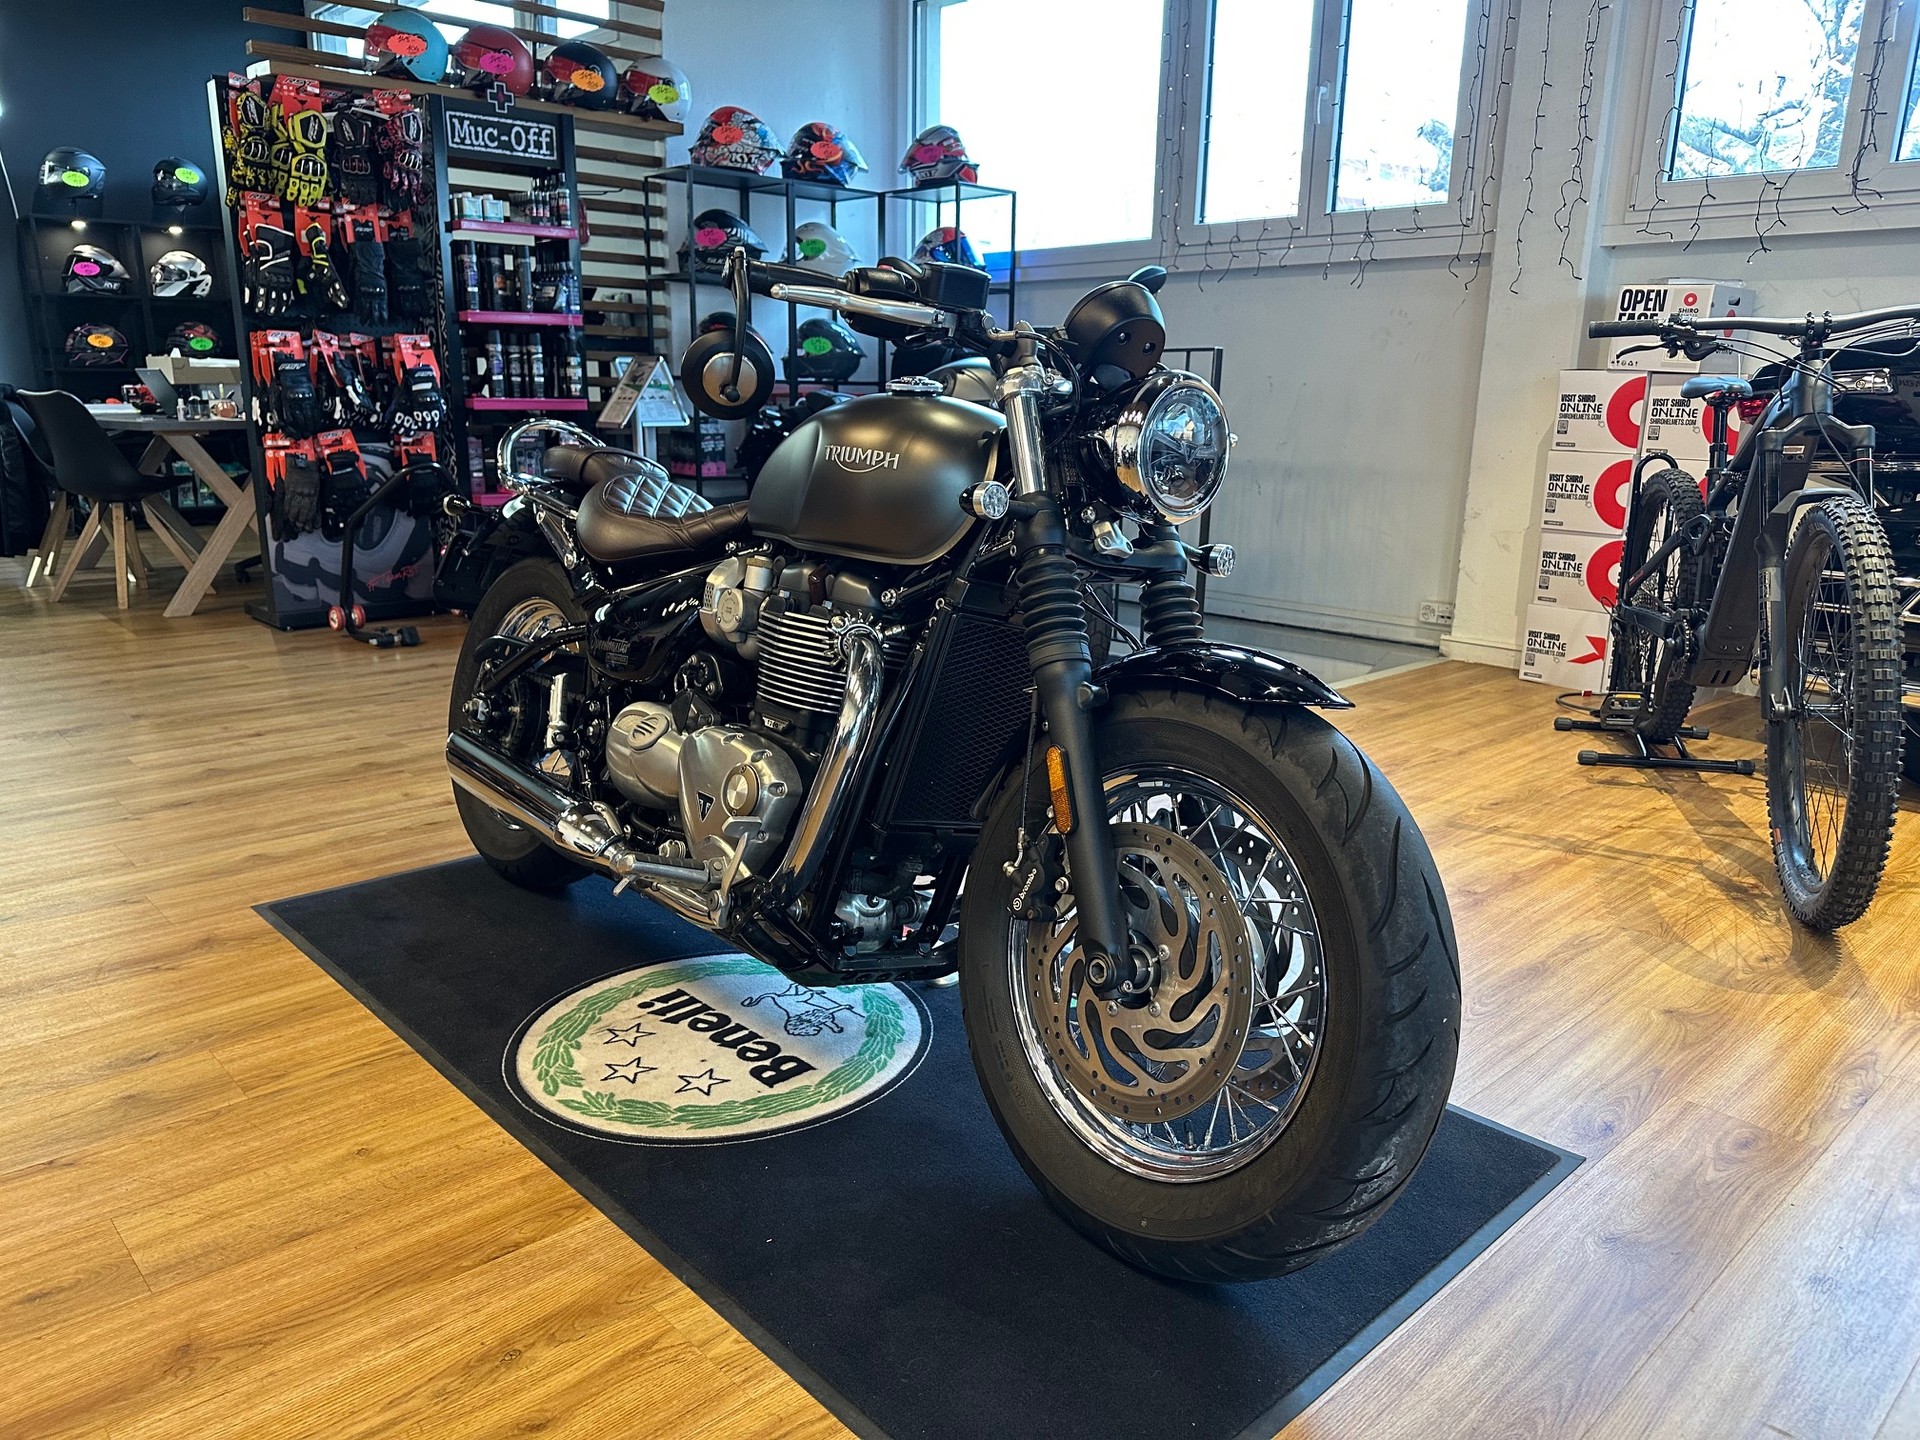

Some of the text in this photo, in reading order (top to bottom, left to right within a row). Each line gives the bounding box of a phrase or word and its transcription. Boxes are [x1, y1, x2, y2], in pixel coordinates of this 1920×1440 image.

[284, 77, 316, 87] RST
[451, 118, 551, 155] Muc-Off
[1619, 288, 1668, 312] OPEN
[1561, 394, 1596, 403] VISIT SHIRO
[1652, 398, 1691, 407] VISIT SHIRO
[1560, 403, 1603, 413] ONLINE
[1651, 407, 1698, 418] ONLINE
[824, 444, 900, 472] TRIUMPH
[1548, 473, 1584, 483] VISIT SHIRO
[1548, 482, 1590, 494] ONLINE
[1542, 550, 1576, 561] VISIT SHIRO
[1541, 559, 1583, 572] ONLINE
[1527, 637, 1567, 651] ONLINE
[1018, 868, 1038, 900] brembo
[637, 987, 818, 1089] Benelli
